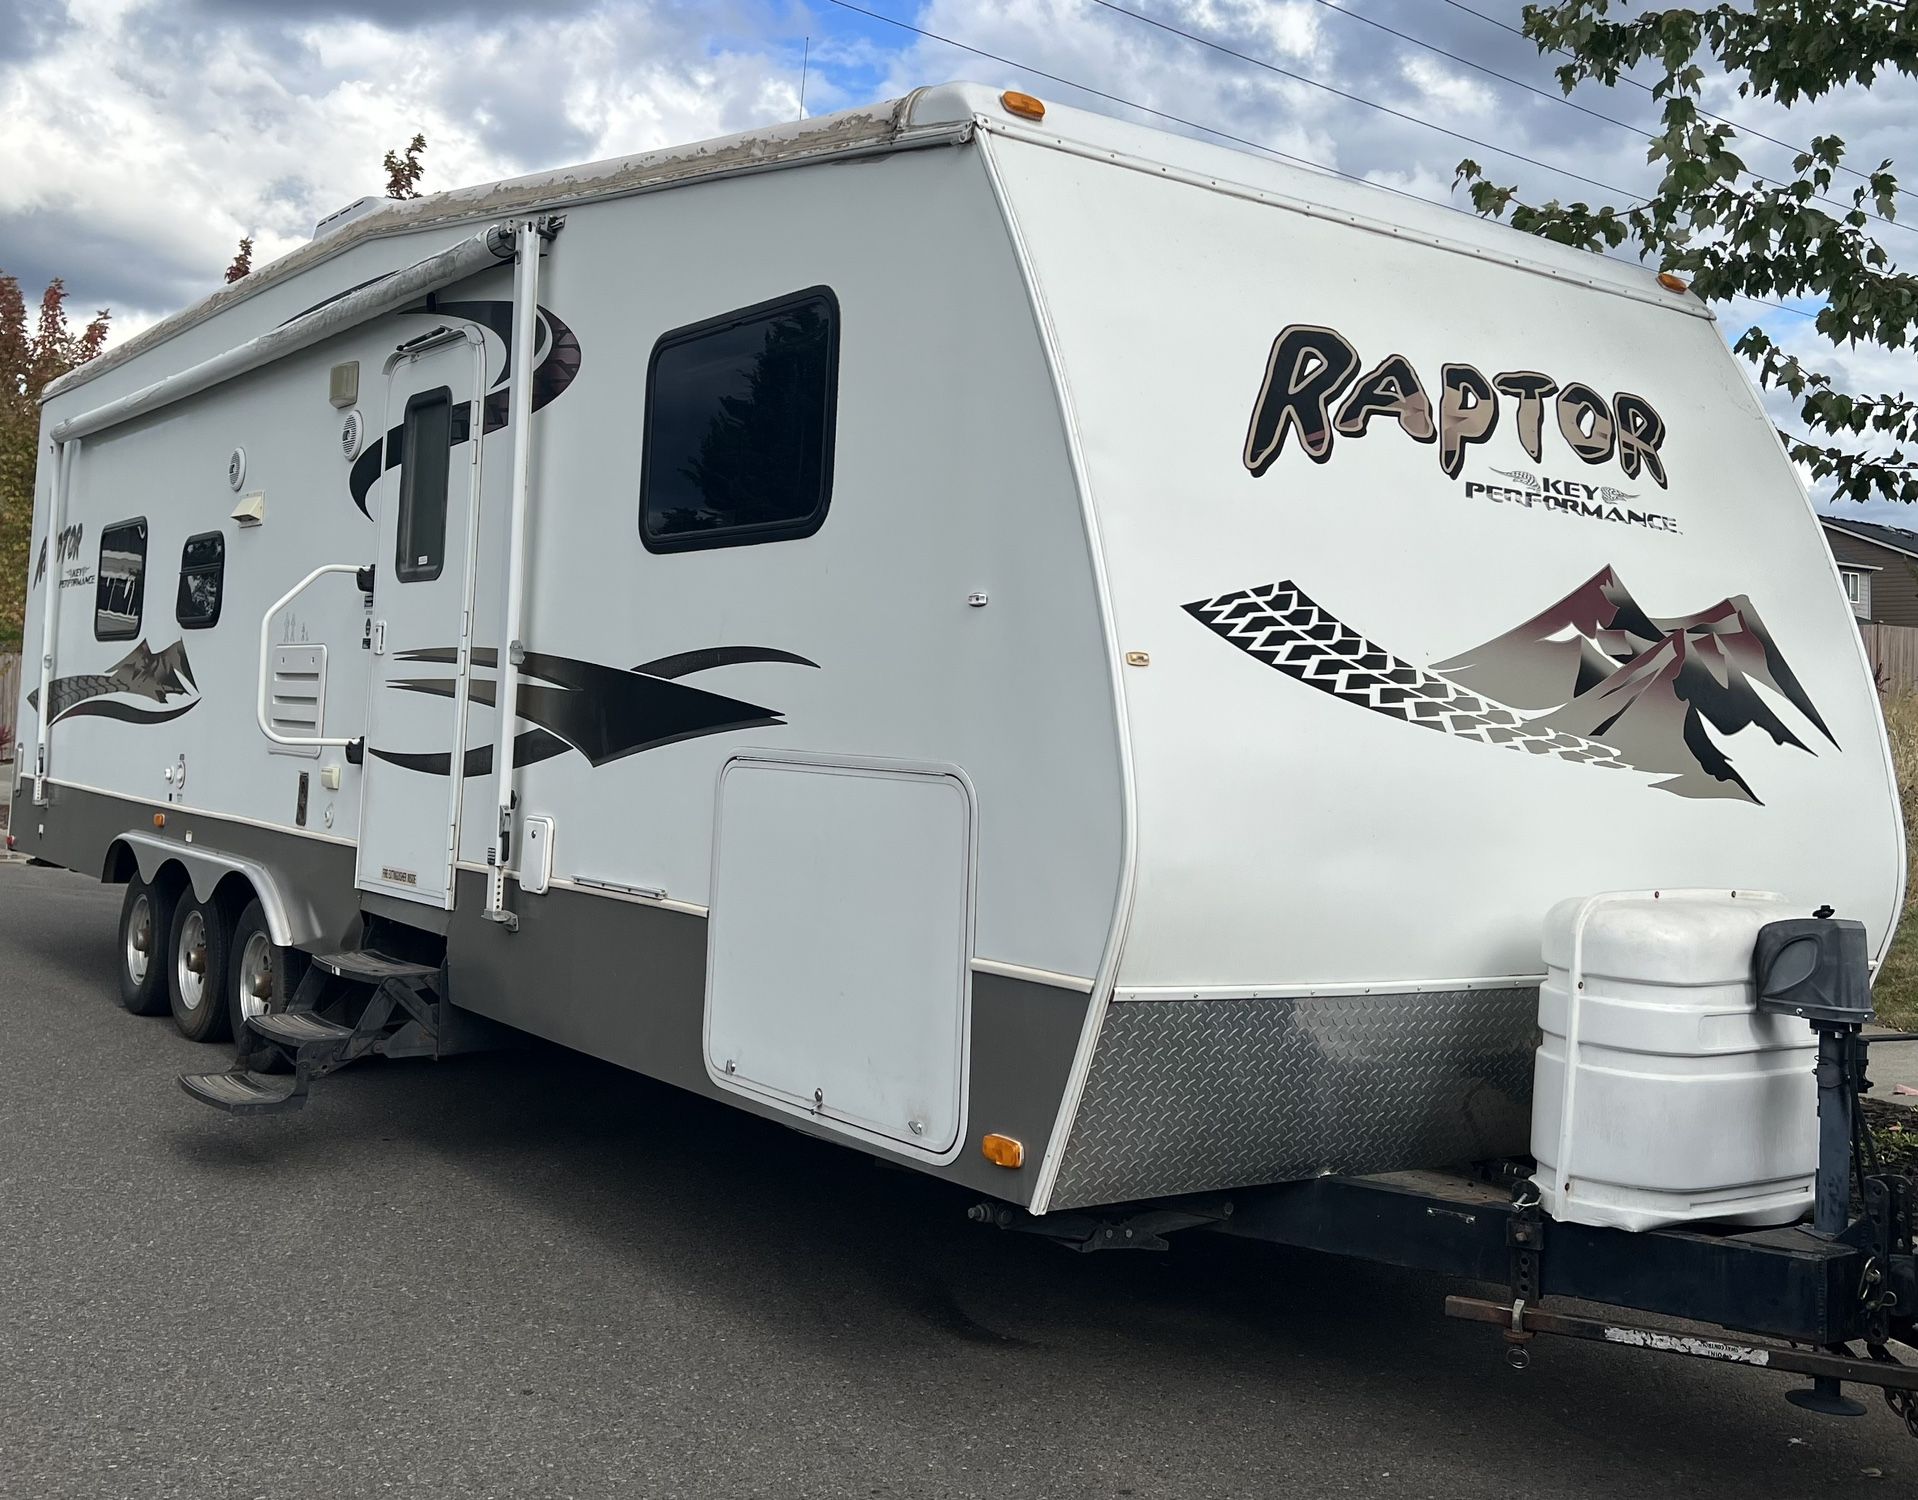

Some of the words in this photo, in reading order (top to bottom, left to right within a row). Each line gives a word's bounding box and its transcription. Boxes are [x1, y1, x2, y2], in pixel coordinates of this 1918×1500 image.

[1243, 324, 1669, 490] RAPTOR
[1465, 481, 1679, 534] PERFORMANCE
[1542, 477, 1600, 500] KEY
[33, 522, 83, 590] RPTOR
